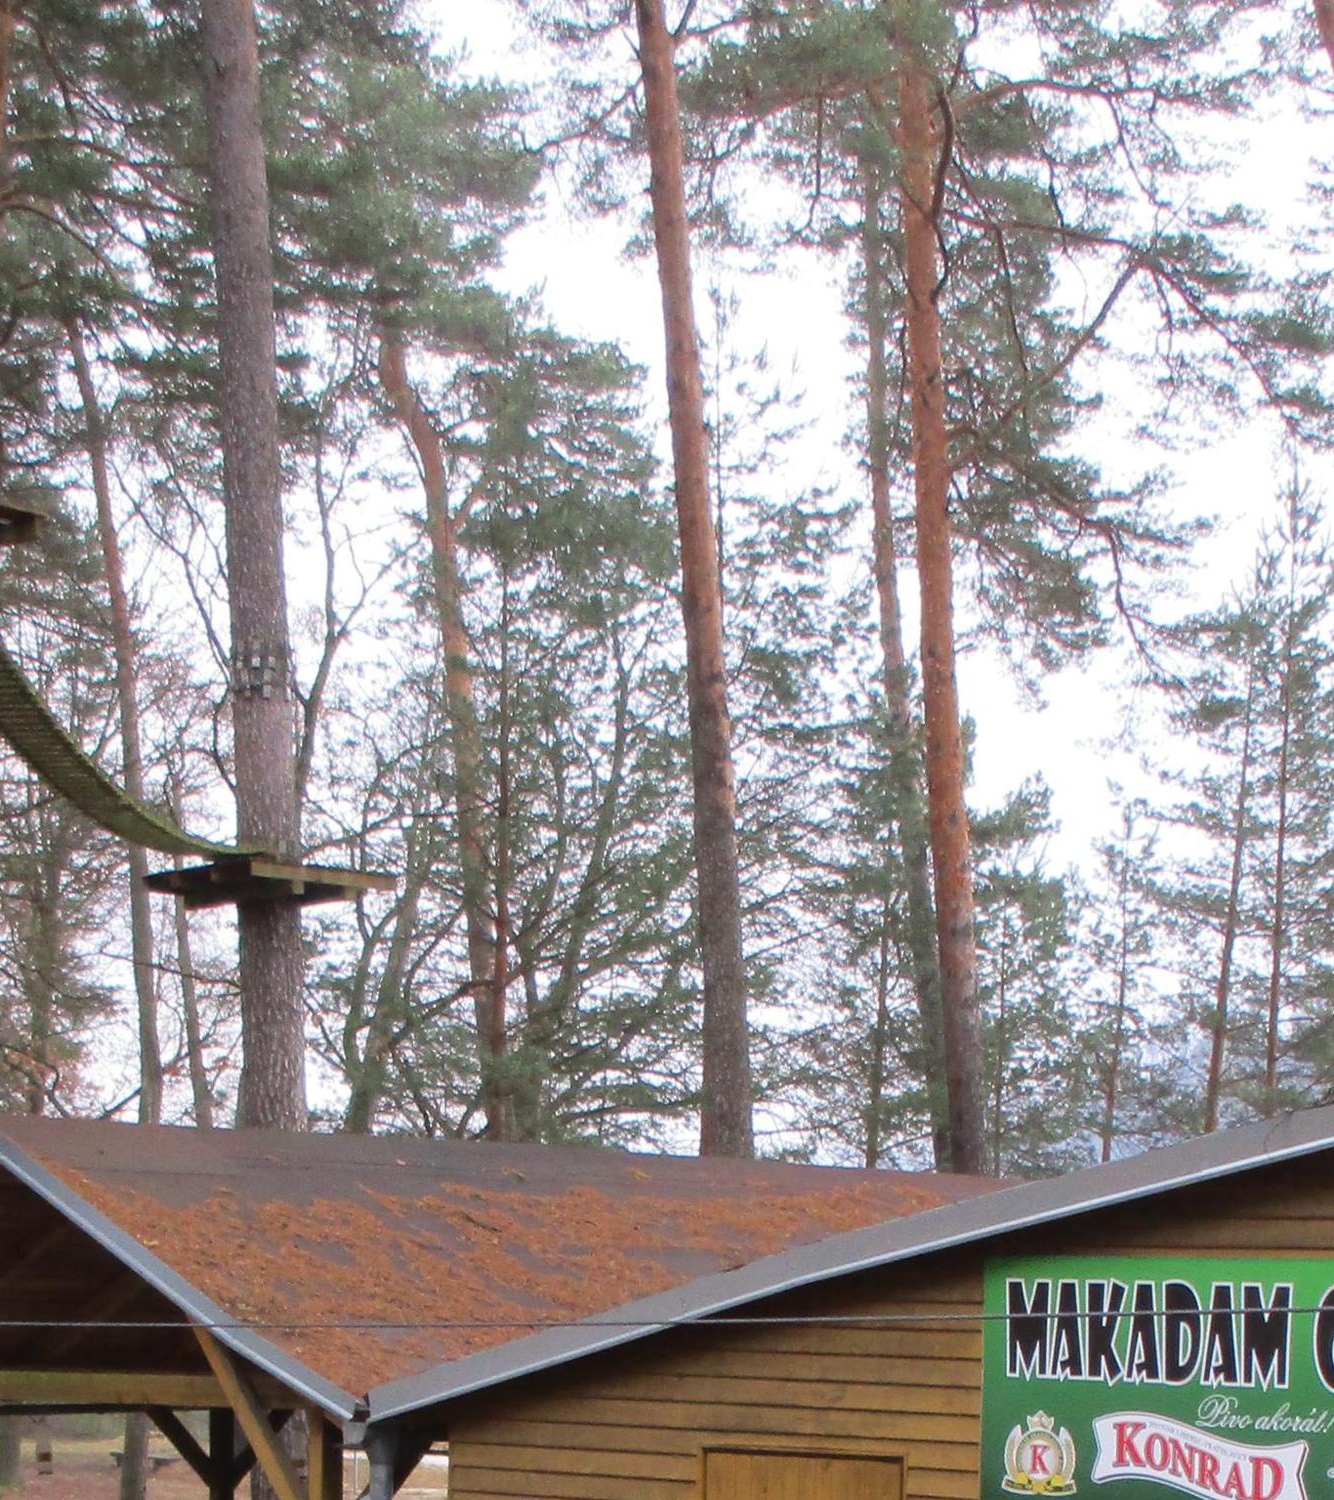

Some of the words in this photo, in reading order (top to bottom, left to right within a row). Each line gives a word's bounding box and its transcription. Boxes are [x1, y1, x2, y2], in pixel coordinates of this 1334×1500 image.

[1005, 1278, 1294, 1390] MAKADAM
[1195, 1394, 1252, 1429] Pivo
[1028, 1444, 1052, 1475] K
